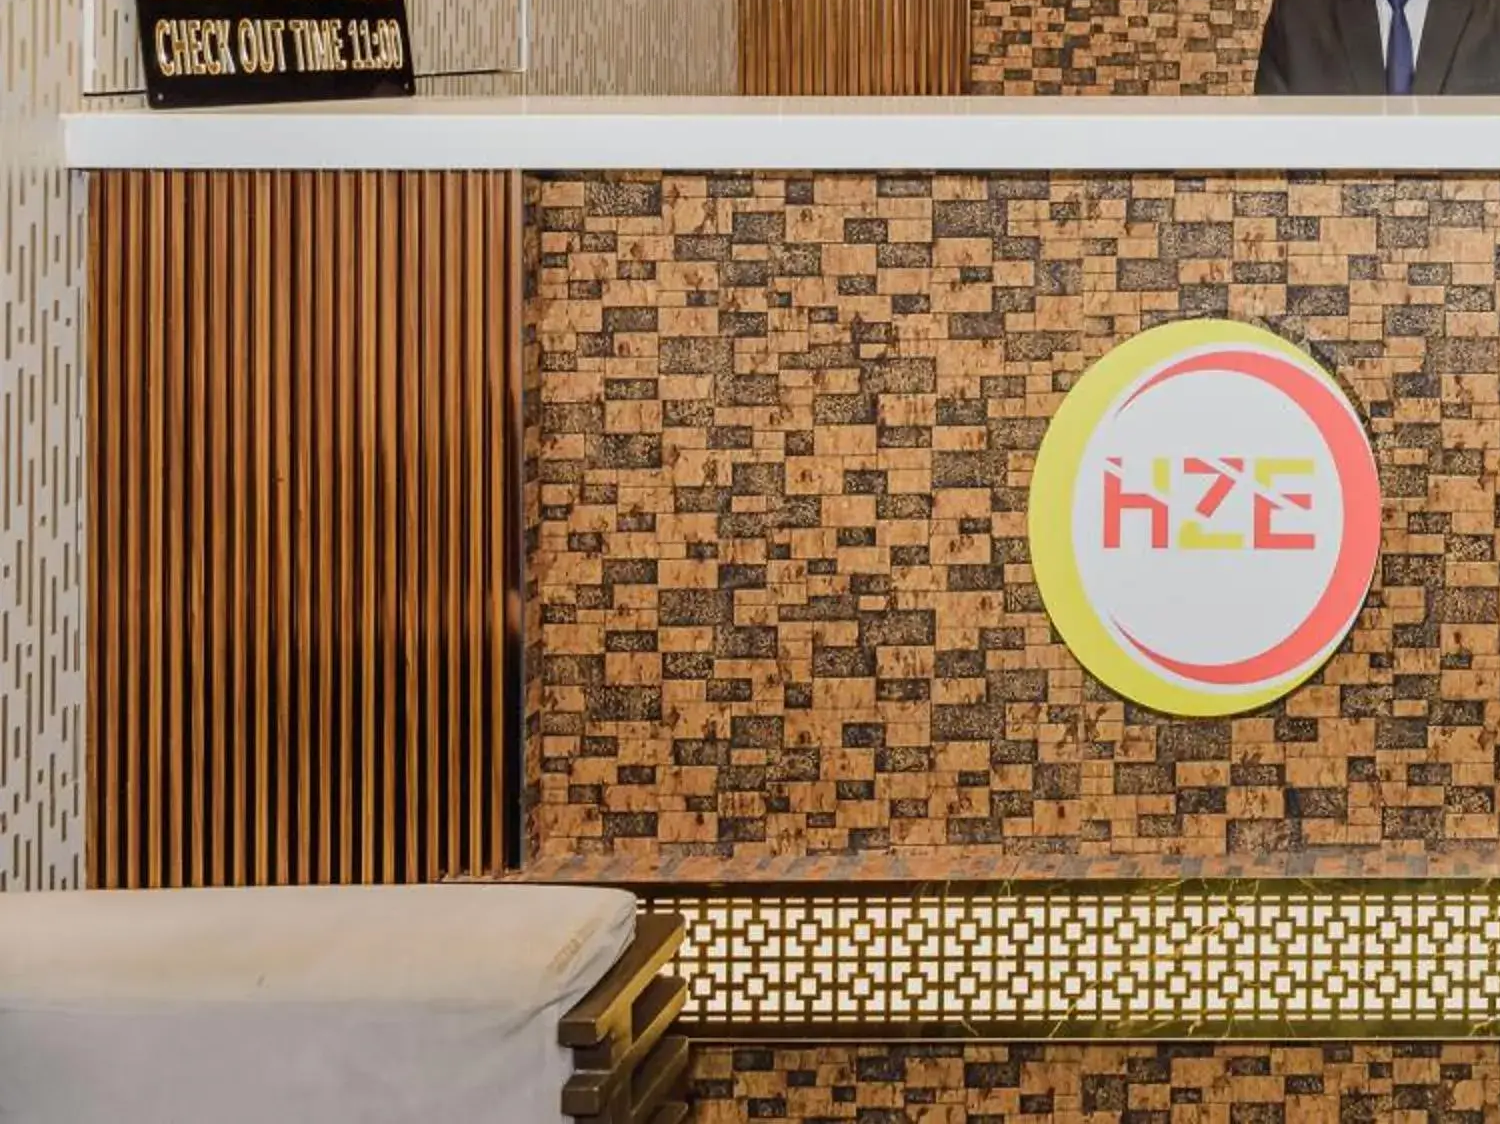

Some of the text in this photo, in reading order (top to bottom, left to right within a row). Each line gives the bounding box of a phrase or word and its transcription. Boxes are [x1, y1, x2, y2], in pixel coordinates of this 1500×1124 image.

[155, 18, 403, 76] CHECK OUT TIME 11:00
